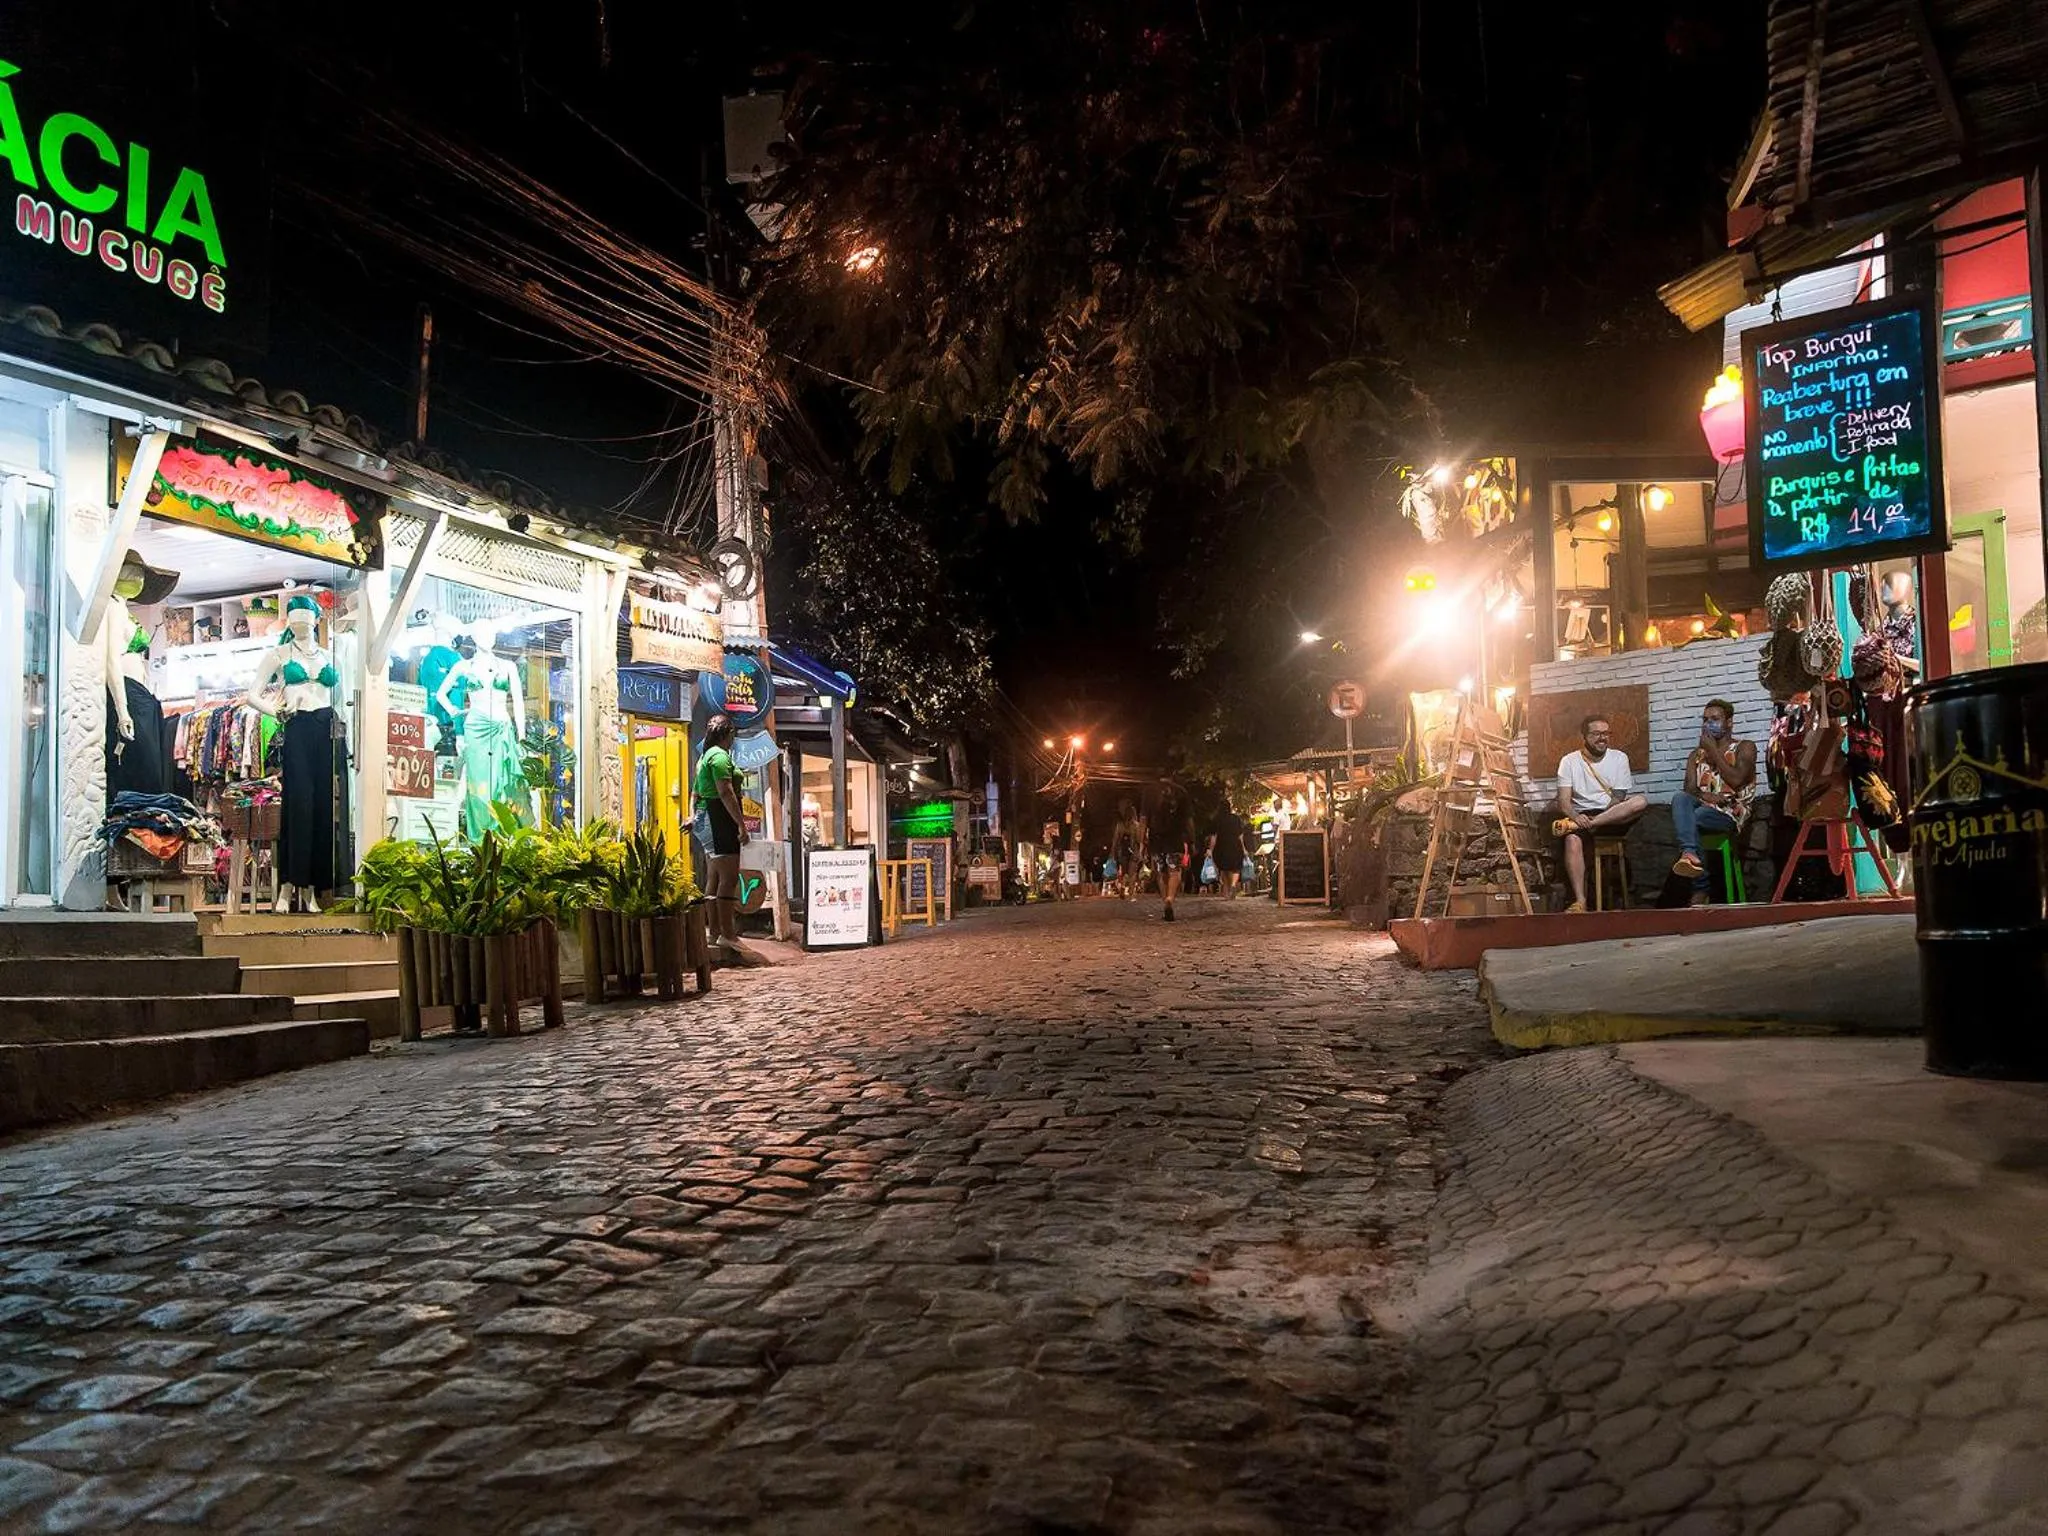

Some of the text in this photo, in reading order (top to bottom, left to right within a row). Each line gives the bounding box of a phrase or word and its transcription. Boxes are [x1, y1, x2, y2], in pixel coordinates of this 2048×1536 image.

[16, 193, 225, 313] MUCUGÊ
[1761, 323, 1873, 373] Top Burgui
[1761, 365, 1909, 408] Reabertura em
[1784, 399, 1836, 422] breve
[1762, 427, 1828, 460] momento
[1863, 453, 1921, 490] fritas
[1791, 488, 1849, 521] partir
[1869, 481, 1899, 499] de
[1801, 512, 1831, 543] R$
[391, 722, 421, 739] 30%
